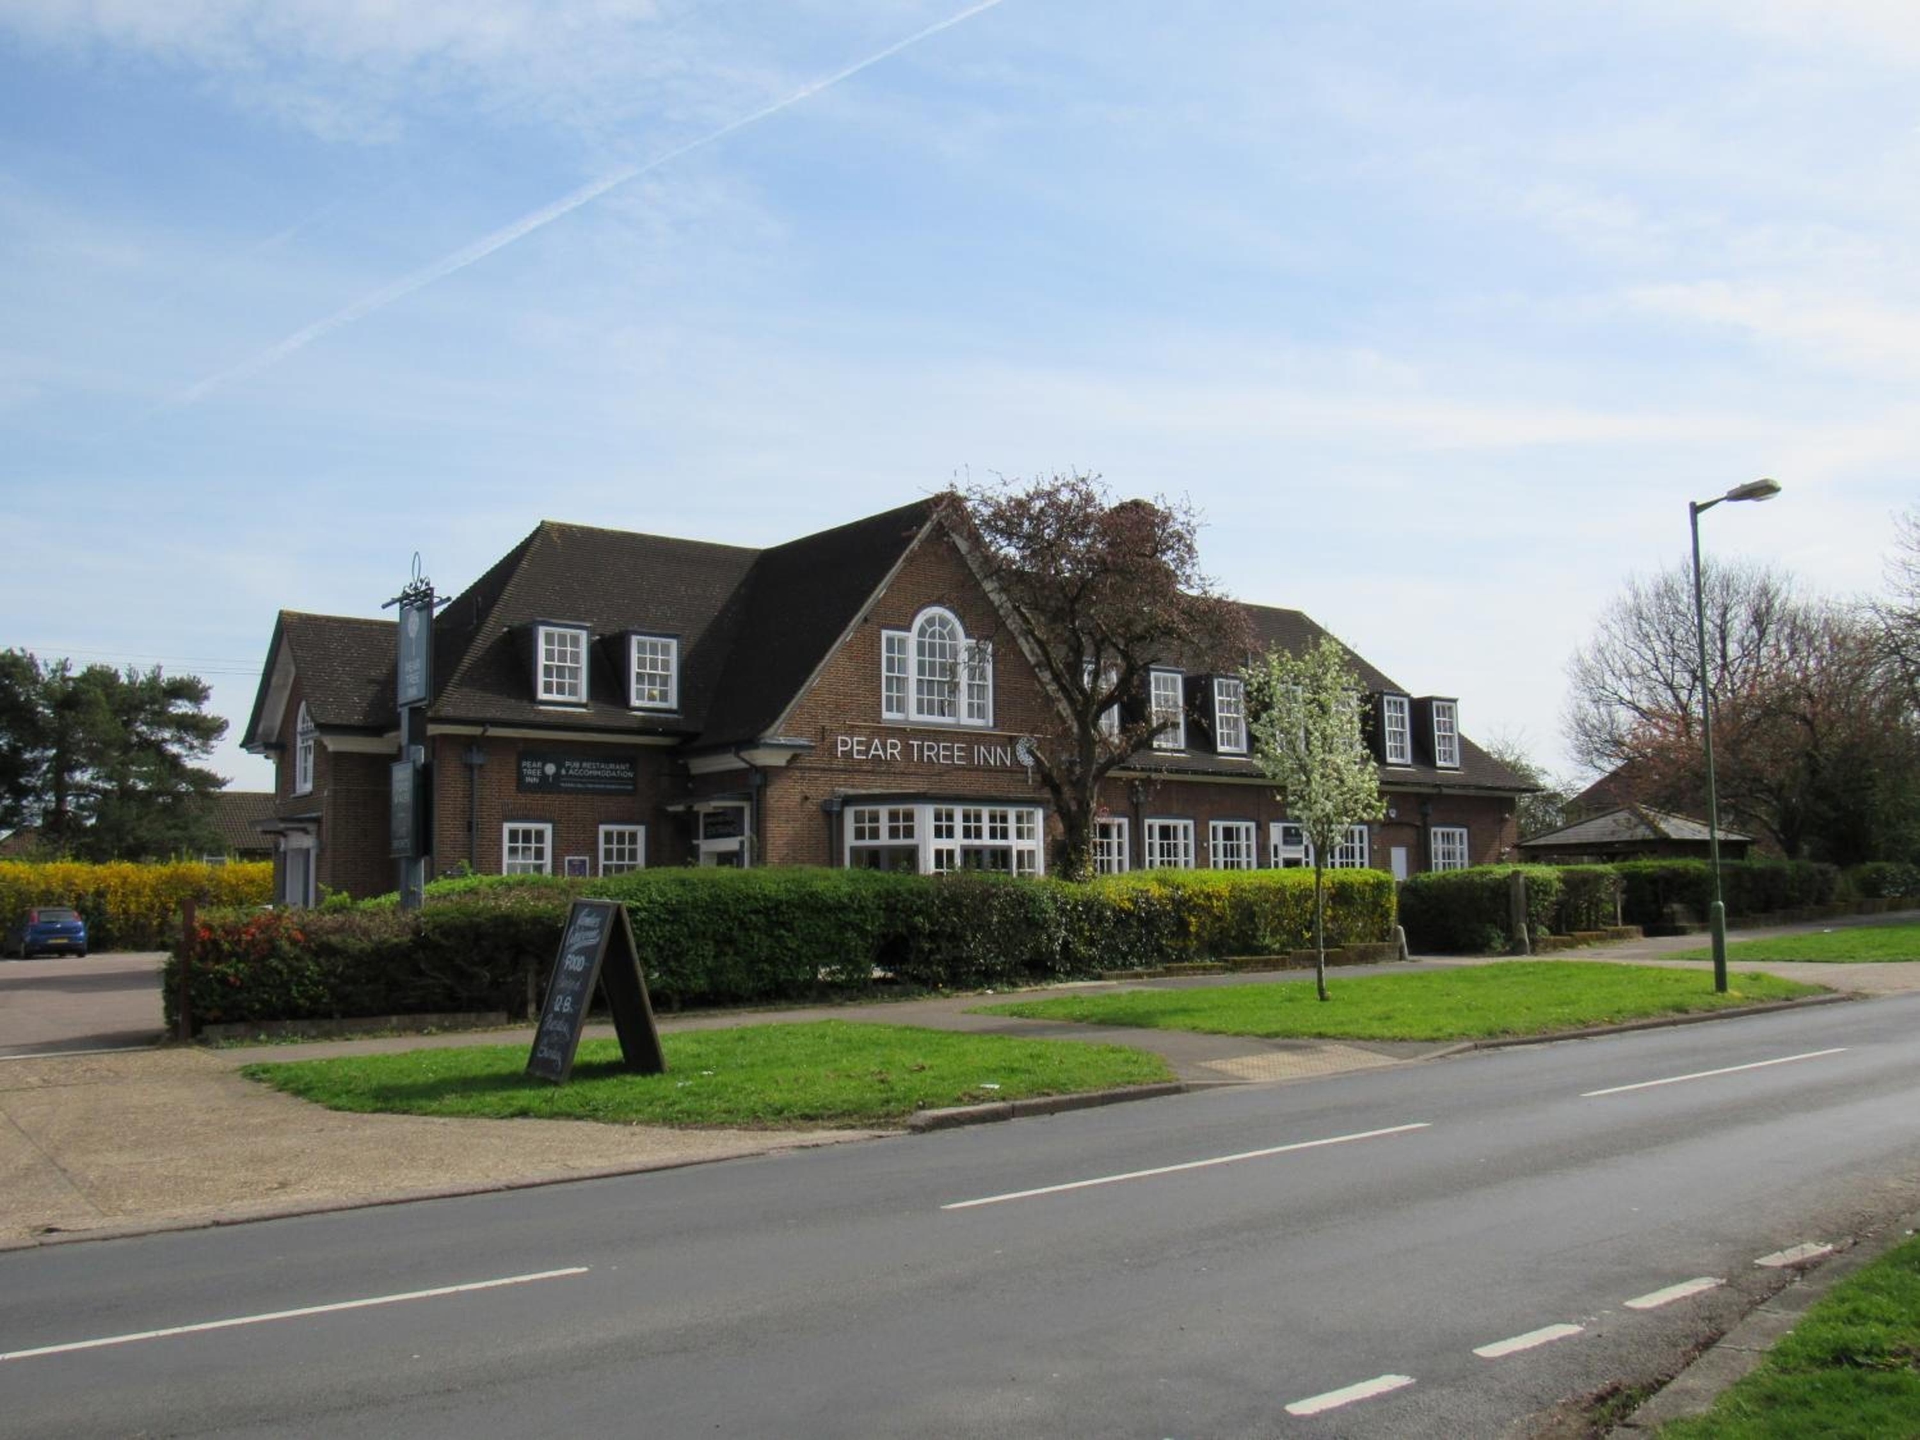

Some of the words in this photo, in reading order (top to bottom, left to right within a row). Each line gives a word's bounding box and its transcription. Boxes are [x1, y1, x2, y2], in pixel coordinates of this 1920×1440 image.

[837, 736, 901, 761] PEAR
[908, 740, 967, 765] TREE
[973, 744, 1011, 767] INN
[521, 761, 542, 769] PEAR
[565, 761, 580, 769] PUB
[582, 762, 630, 771] RESTAURANT
[522, 768, 542, 776] TREE
